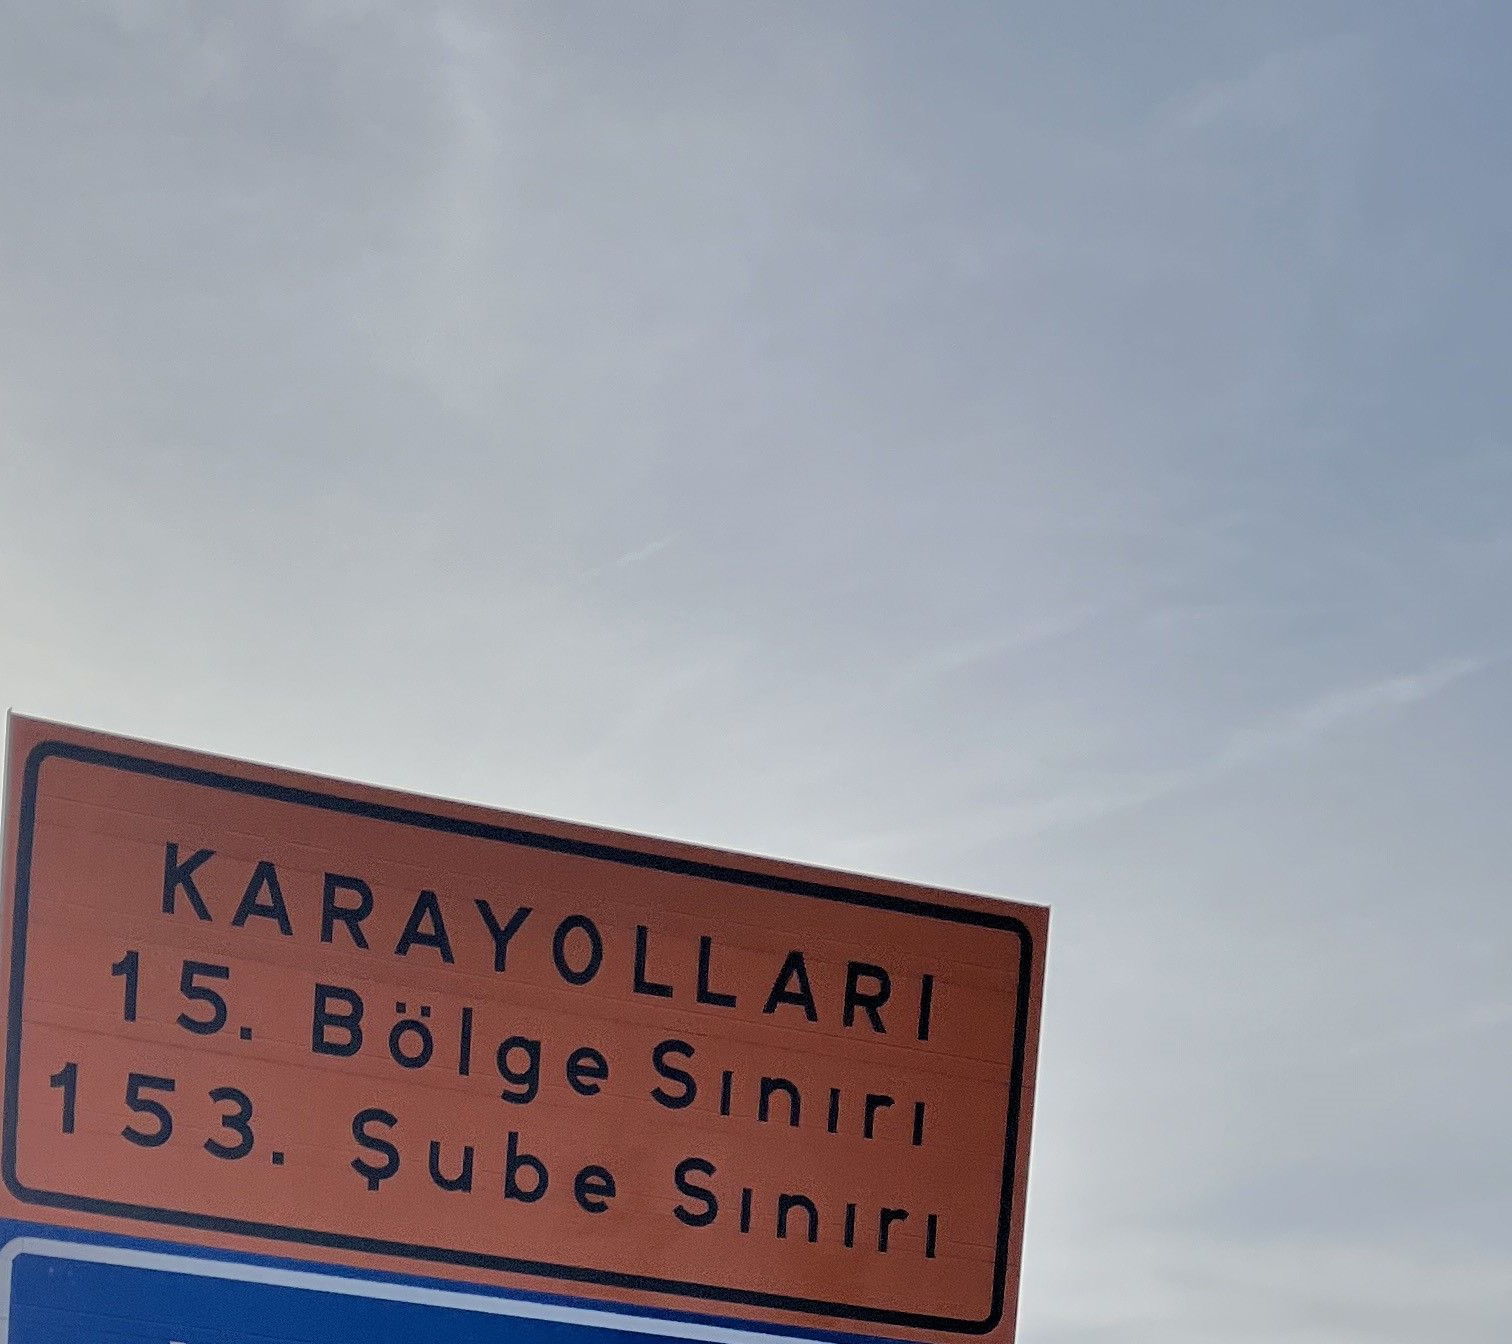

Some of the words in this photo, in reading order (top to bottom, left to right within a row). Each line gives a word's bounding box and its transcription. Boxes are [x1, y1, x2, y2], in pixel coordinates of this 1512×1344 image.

[160, 840, 936, 1043] KARAYOLLARI
[110, 950, 254, 1041] 15.
[312, 982, 610, 1105] Bölge
[649, 1039, 928, 1149] Sınırı
[49, 1062, 286, 1166] 153.
[351, 1107, 617, 1216] Şube
[672, 1157, 941, 1261] Sınırı
